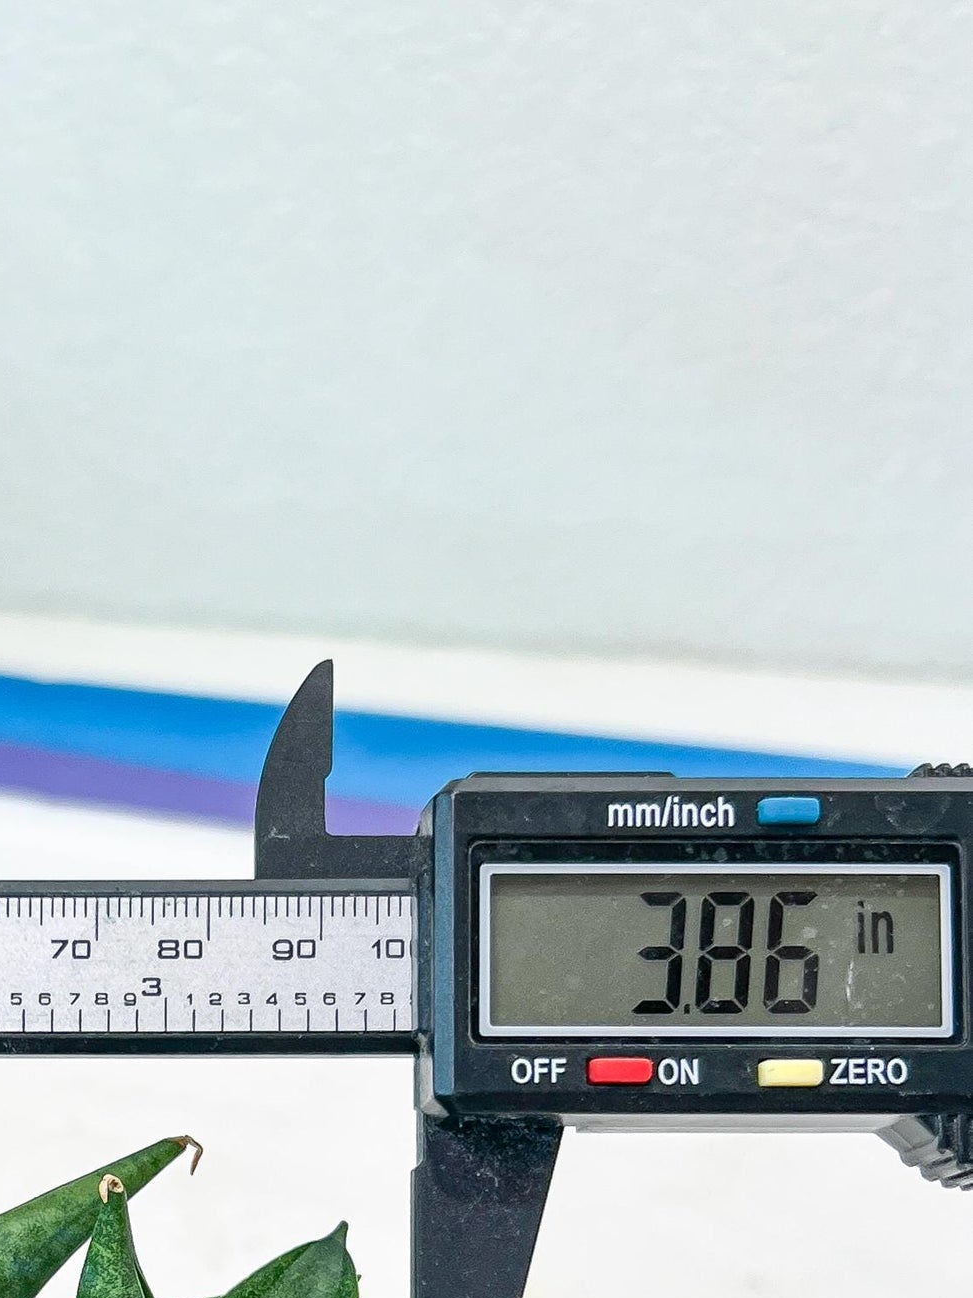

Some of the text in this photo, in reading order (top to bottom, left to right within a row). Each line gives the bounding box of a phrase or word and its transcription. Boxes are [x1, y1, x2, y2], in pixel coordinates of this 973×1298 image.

[607, 796, 735, 828] mm/inch
[51, 939, 92, 960] 70
[157, 939, 204, 960] 80
[272, 938, 317, 960] 90
[372, 938, 413, 960] 10
[632, 891, 895, 1014] 3.86 in
[11, 993, 22, 1006] 5
[39, 993, 51, 1006] 6
[69, 993, 80, 1005] 7
[95, 993, 108, 1005] 8
[124, 993, 136, 1006] 9
[141, 978, 161, 996] 3
[187, 994, 192, 1005] 1
[209, 993, 221, 1006] 2
[238, 992, 250, 1004] 3
[266, 993, 277, 1006] 4
[295, 993, 307, 1005] 5
[323, 992, 336, 1005] 6
[355, 992, 366, 1005] 7
[381, 992, 394, 1004] 8
[511, 1057, 908, 1085] OFF ON ZERO
